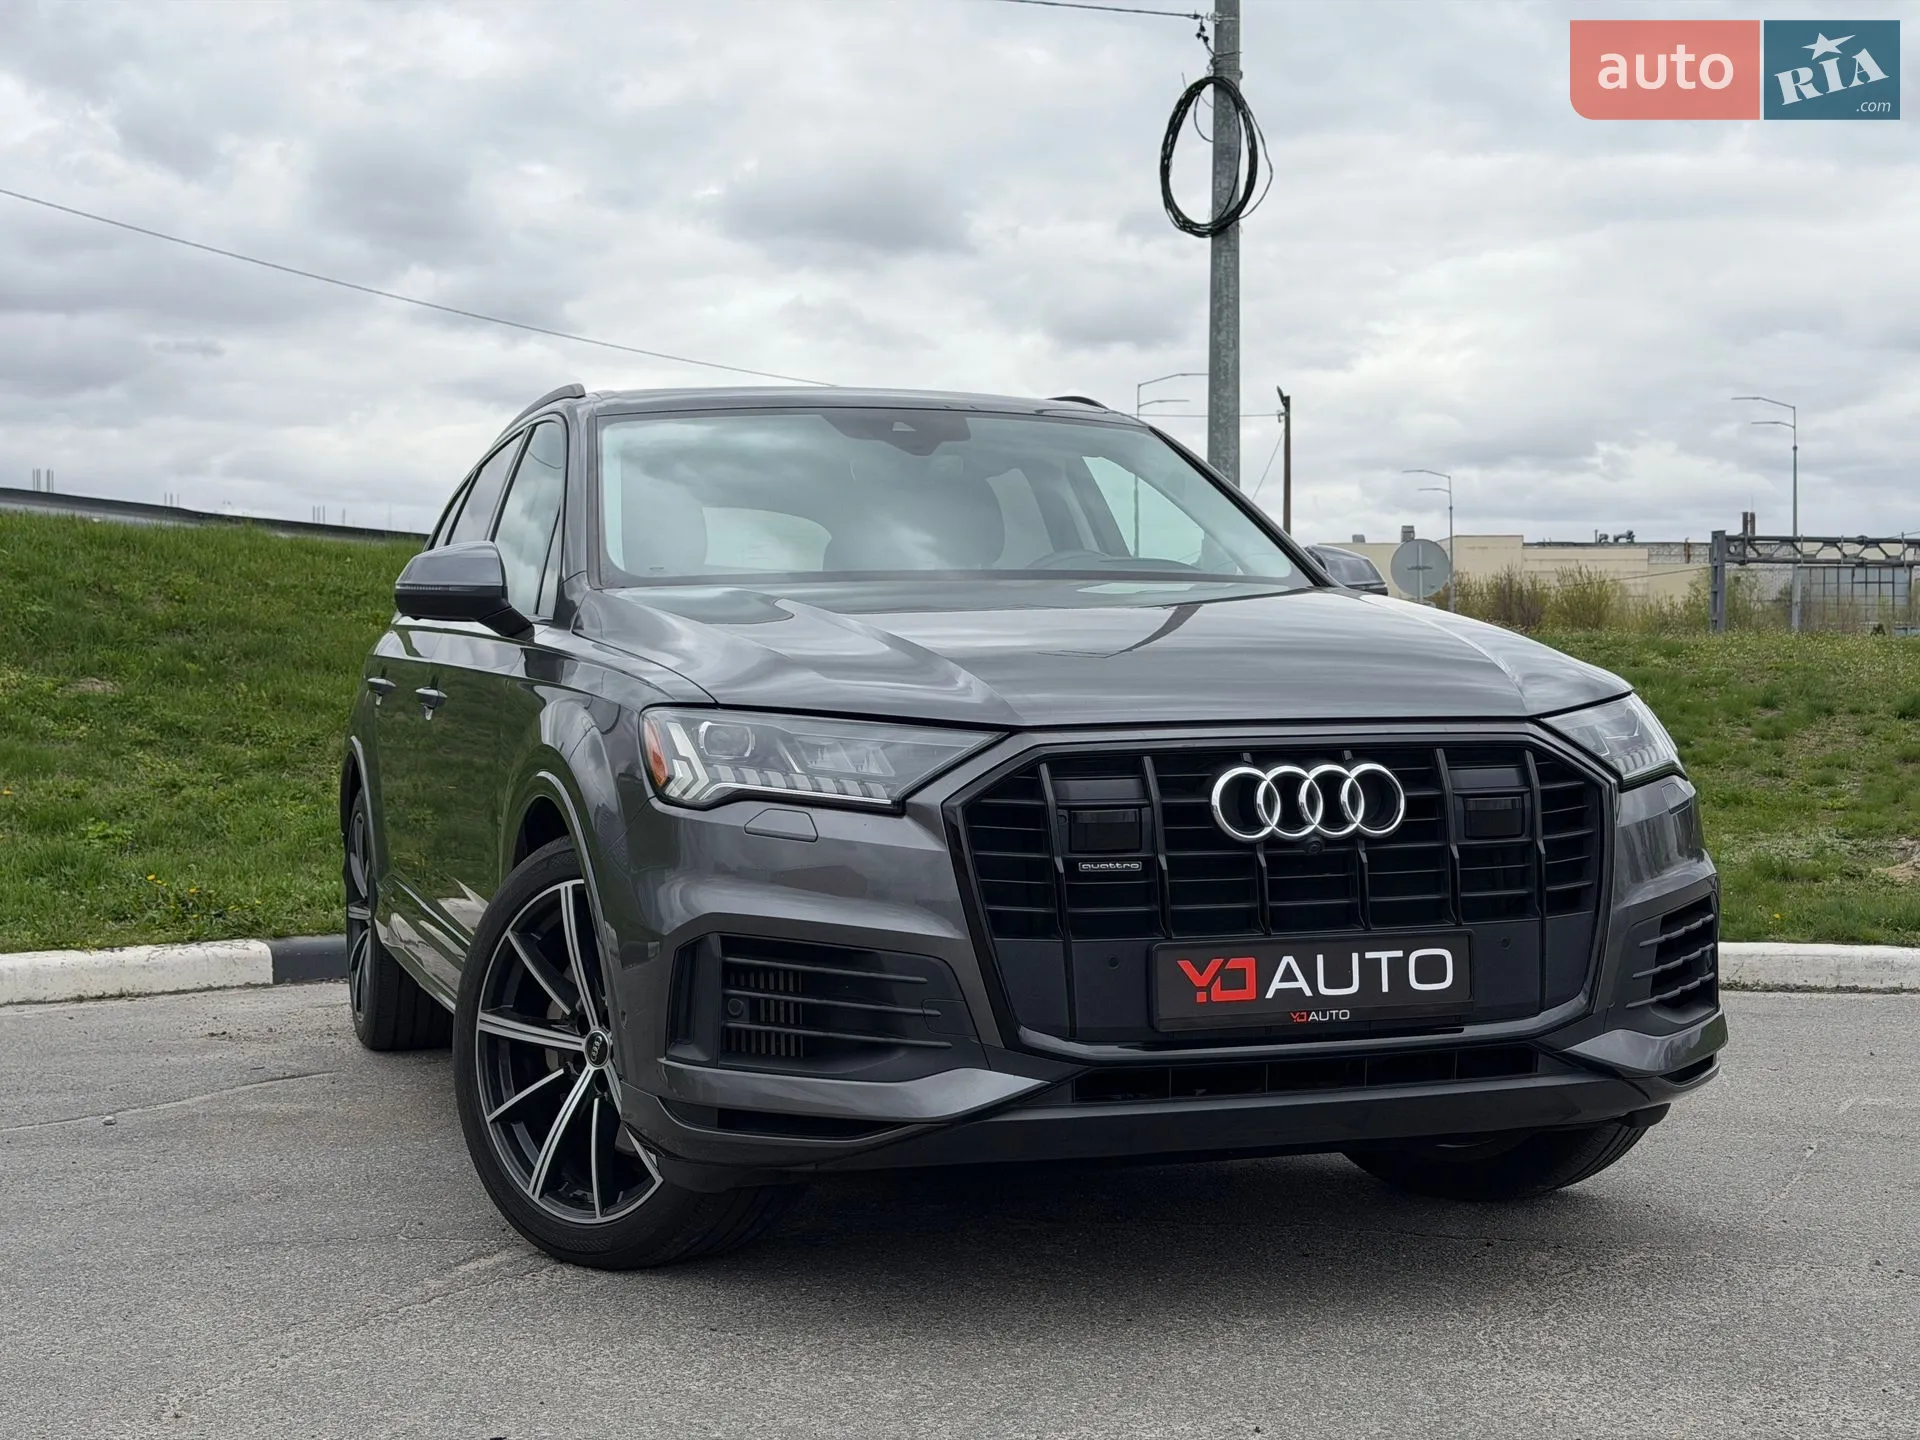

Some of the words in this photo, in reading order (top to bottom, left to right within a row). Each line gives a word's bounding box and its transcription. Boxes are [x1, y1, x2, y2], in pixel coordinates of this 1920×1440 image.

[1081, 863, 1140, 871] quattro
[1265, 948, 1453, 999] AUTO
[1308, 1009, 1350, 1021] AUTO
